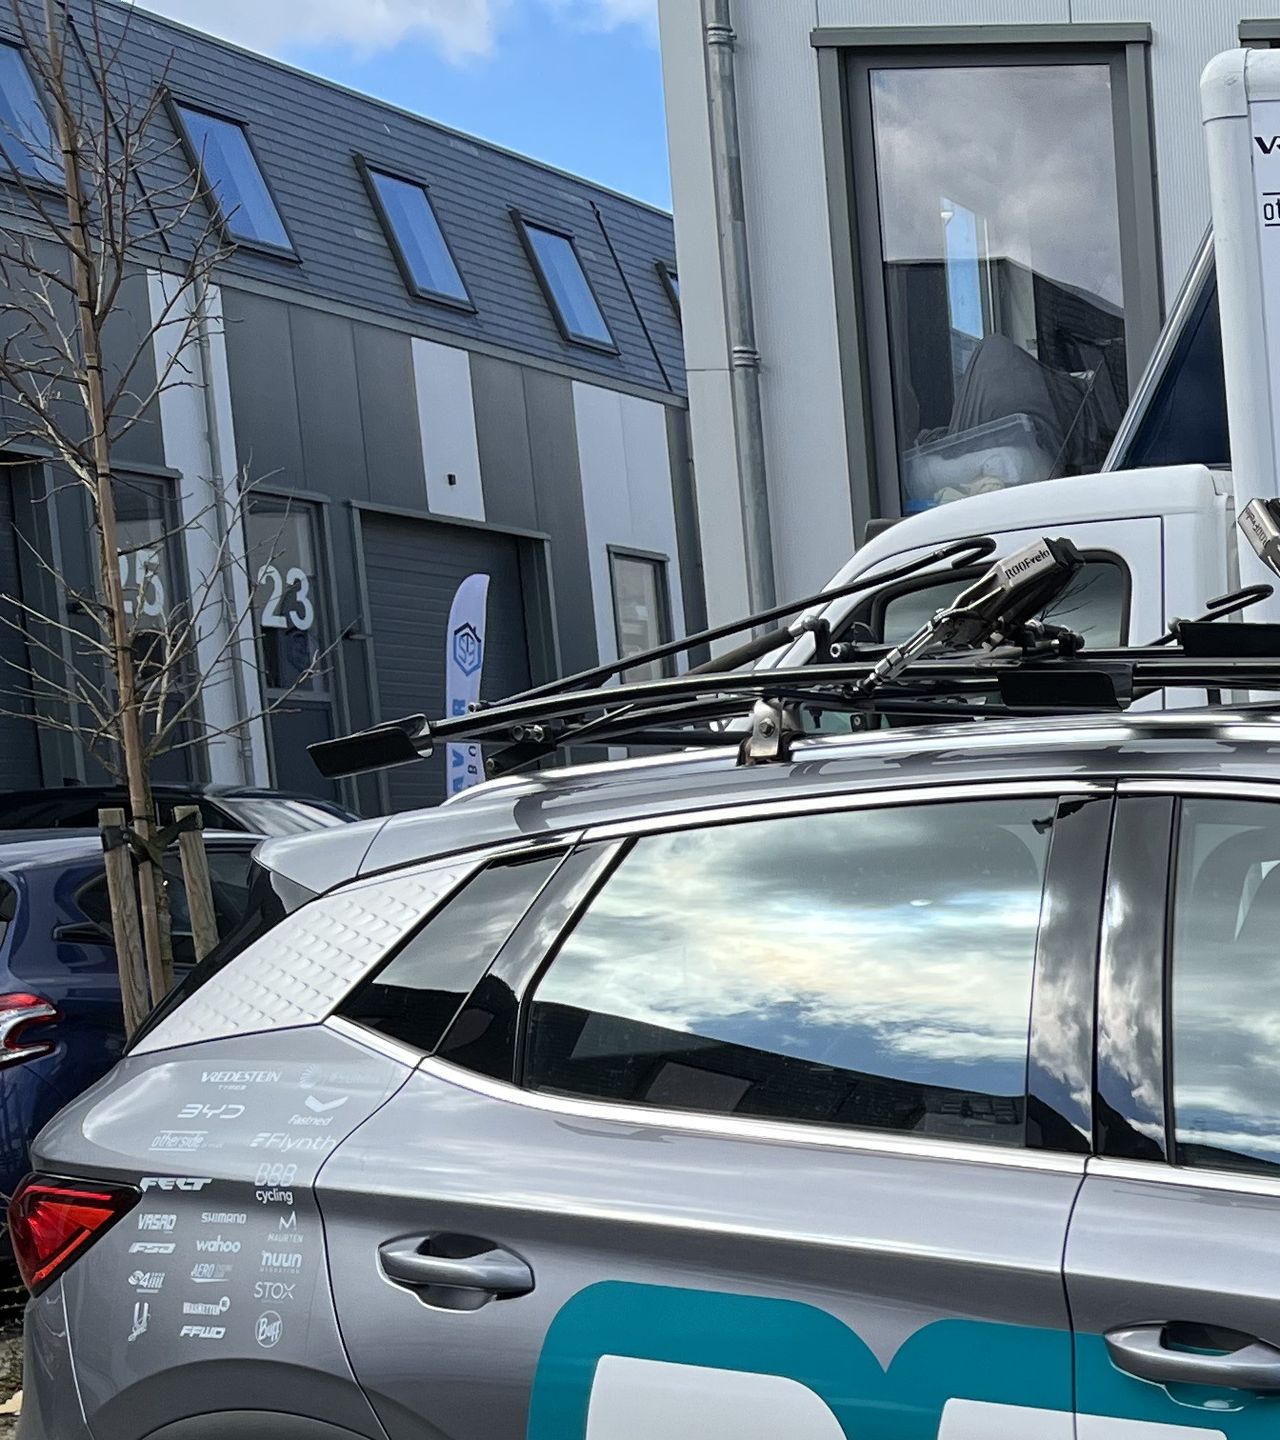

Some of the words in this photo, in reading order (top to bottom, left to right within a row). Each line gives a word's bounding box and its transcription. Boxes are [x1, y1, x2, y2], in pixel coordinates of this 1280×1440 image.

[257, 564, 314, 631] 23
[201, 1071, 283, 1083] VREDESTEIN
[268, 1133, 337, 1153] Flynth
[139, 1177, 215, 1193] FELT
[255, 1188, 293, 1205] cycling
[201, 1212, 247, 1225] SHIMANO
[196, 1235, 242, 1253] wahoo
[254, 1281, 296, 1300] STOX
